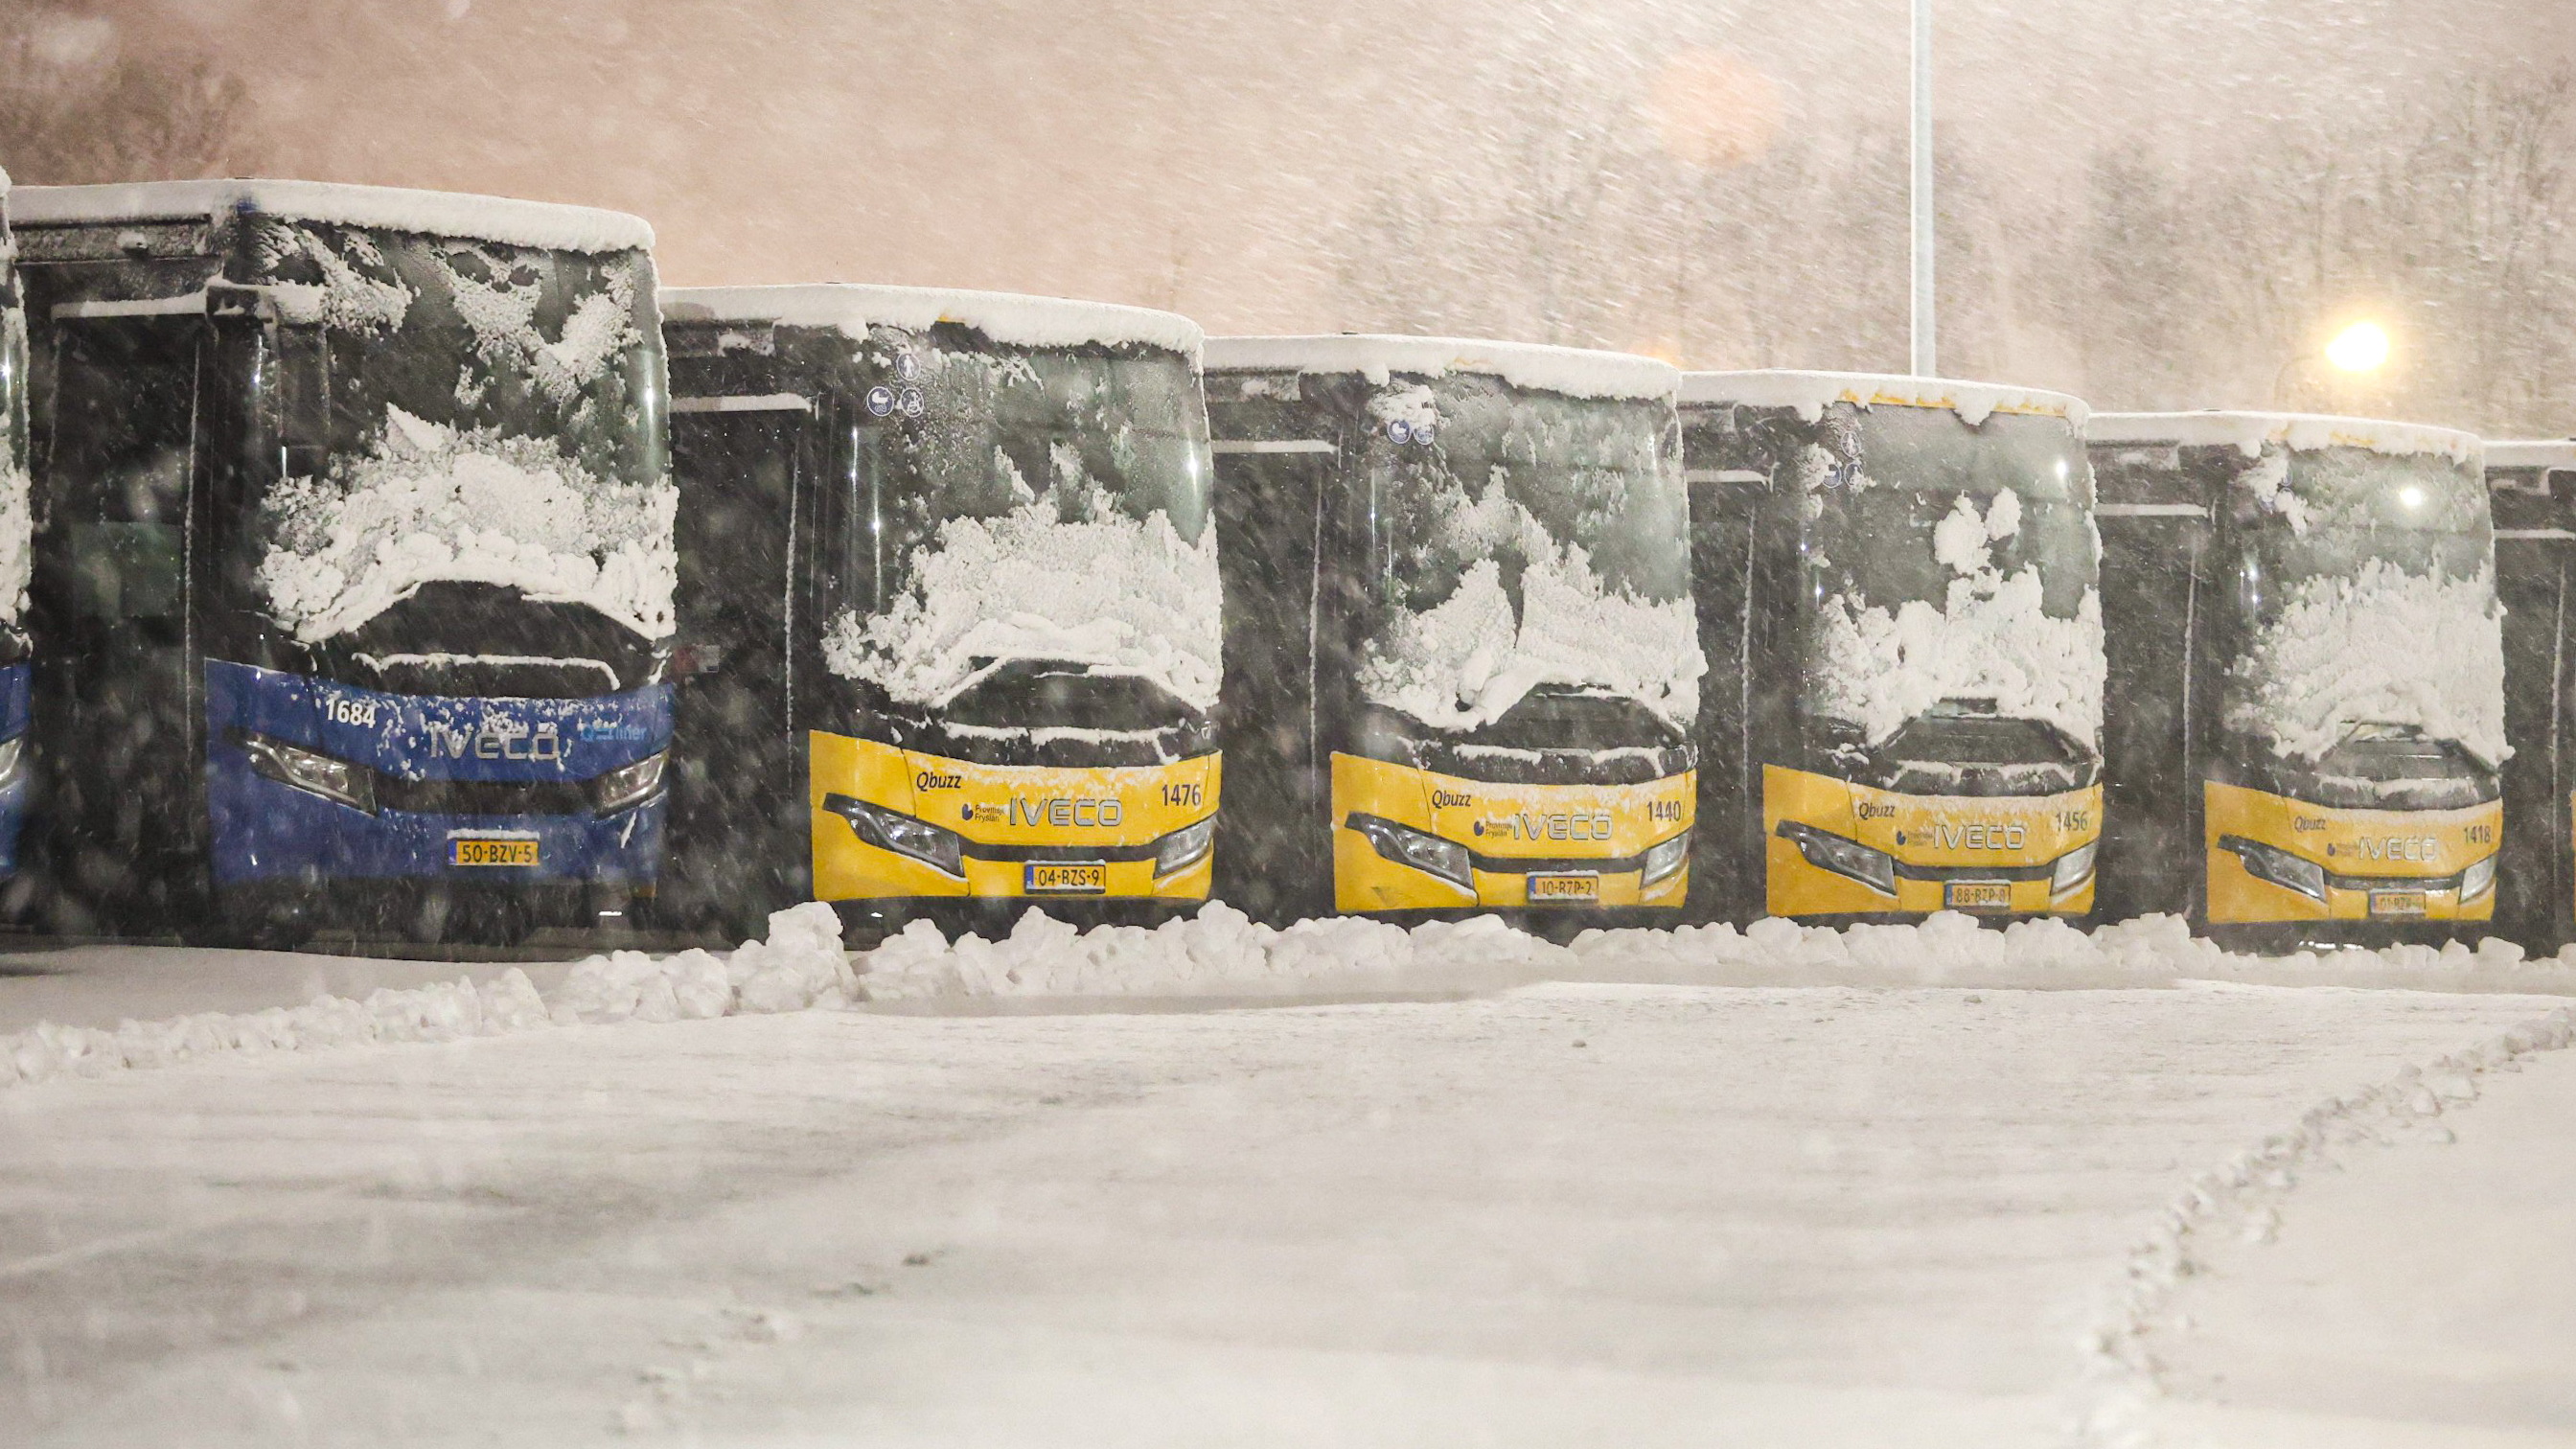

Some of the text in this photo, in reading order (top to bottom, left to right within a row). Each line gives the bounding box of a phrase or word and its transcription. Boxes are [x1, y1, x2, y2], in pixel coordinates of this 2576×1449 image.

[325, 700, 377, 729] 1684
[431, 722, 560, 760] IVECO
[916, 771, 962, 792] Qbuzz
[1162, 784, 1202, 807] 1476
[1432, 790, 1471, 809] Qbuzz
[1009, 797, 1122, 826] IVECO
[1647, 800, 1682, 822] 1440
[1859, 802, 1896, 820] Qbuzz
[2056, 811, 2088, 833] 1456
[1513, 813, 1614, 840] IVECO
[2294, 816, 2326, 833] Qbuzz
[2464, 825, 2491, 843] 1418
[1933, 823, 2026, 849] IVECO
[462, 844, 532, 863] 50-BZV-5
[2358, 836, 2438, 861] IVECO
[1038, 869, 1100, 887] 04-BZS-9
